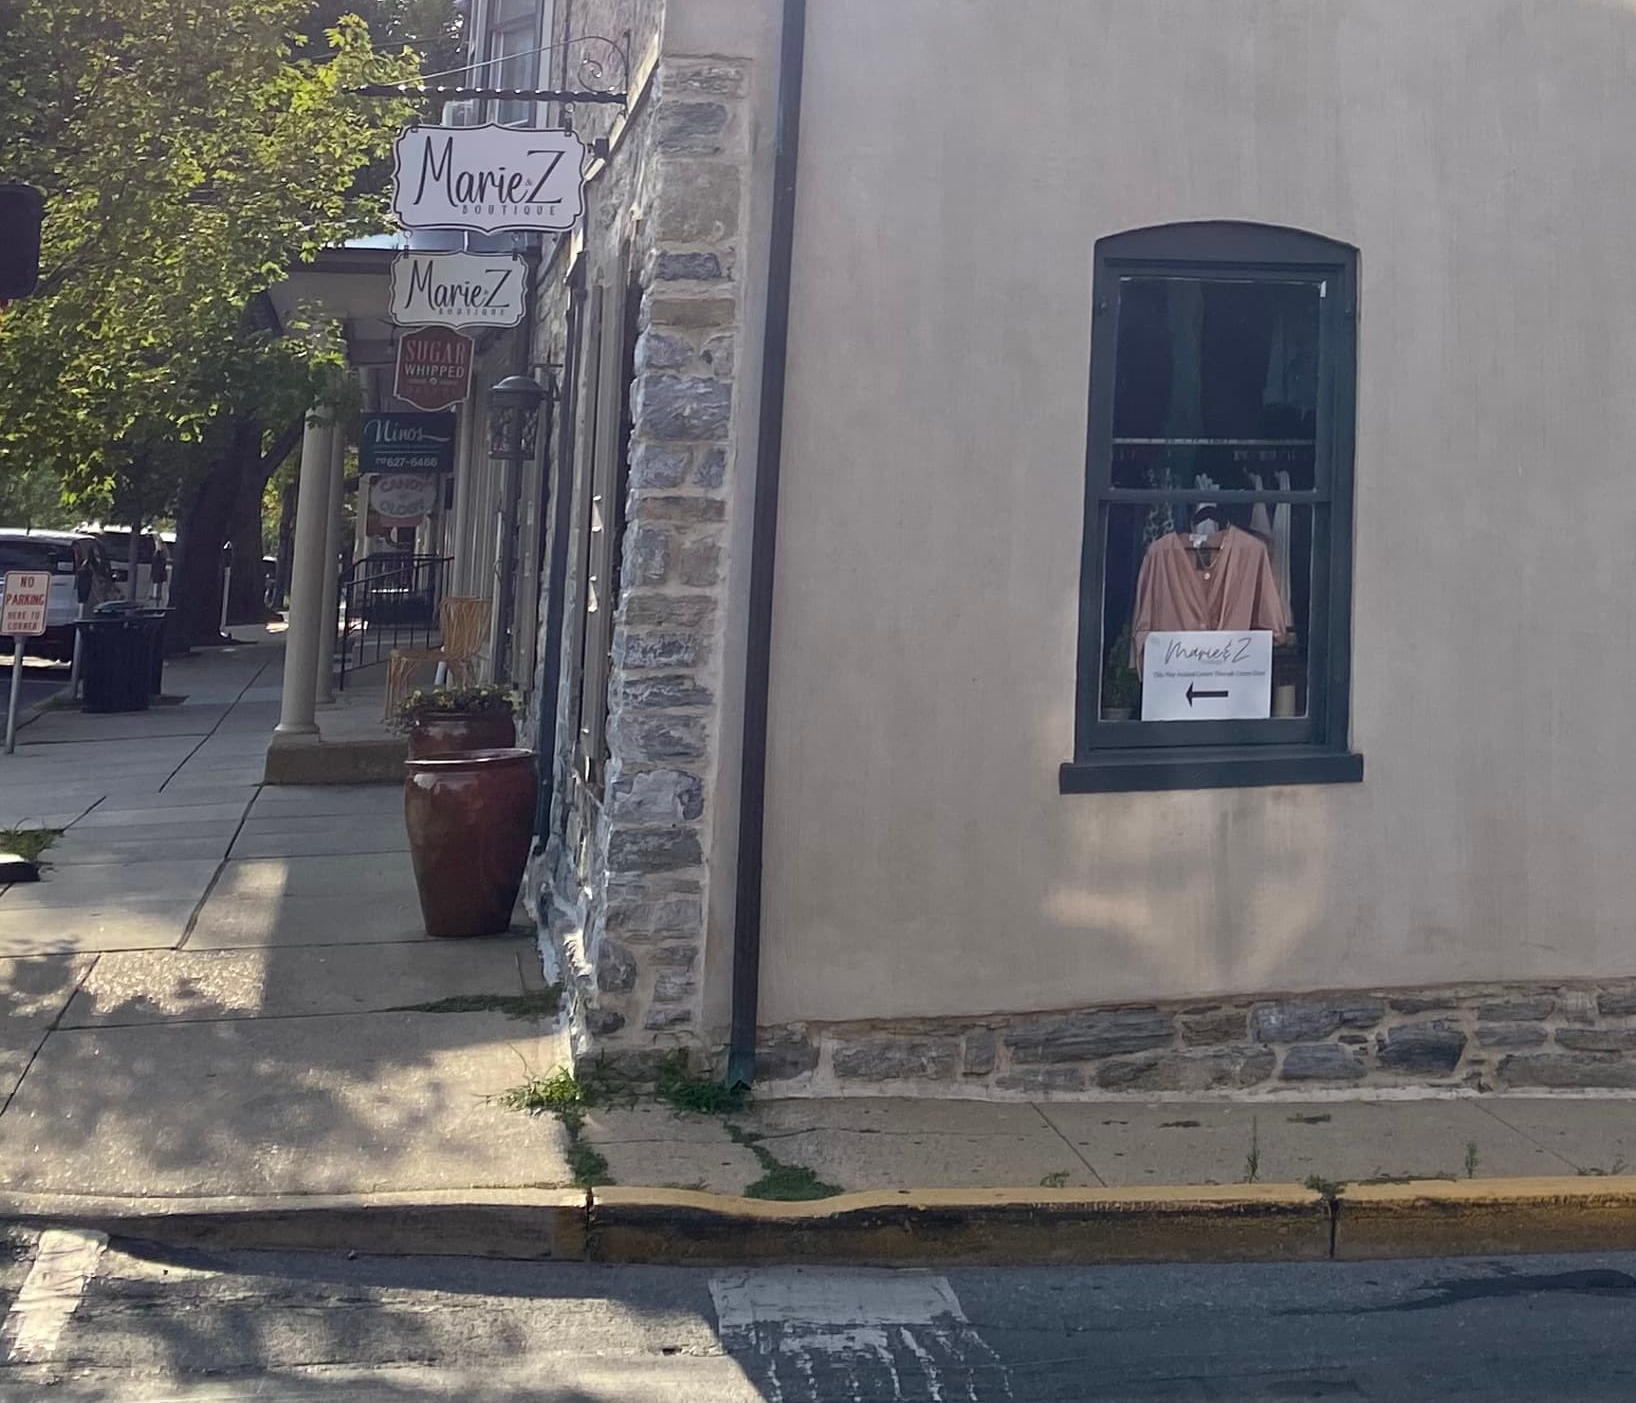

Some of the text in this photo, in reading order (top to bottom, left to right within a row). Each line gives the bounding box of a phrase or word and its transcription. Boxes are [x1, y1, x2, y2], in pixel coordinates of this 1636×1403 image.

[413, 135, 529, 207] Marie
[462, 204, 556, 216] BOUTIQUE
[405, 259, 485, 311] Marie
[405, 340, 466, 364] SUGAR
[405, 364, 465, 378] WHIPPED
[20, 576, 35, 588] NO
[5, 593, 45, 606] PARKING
